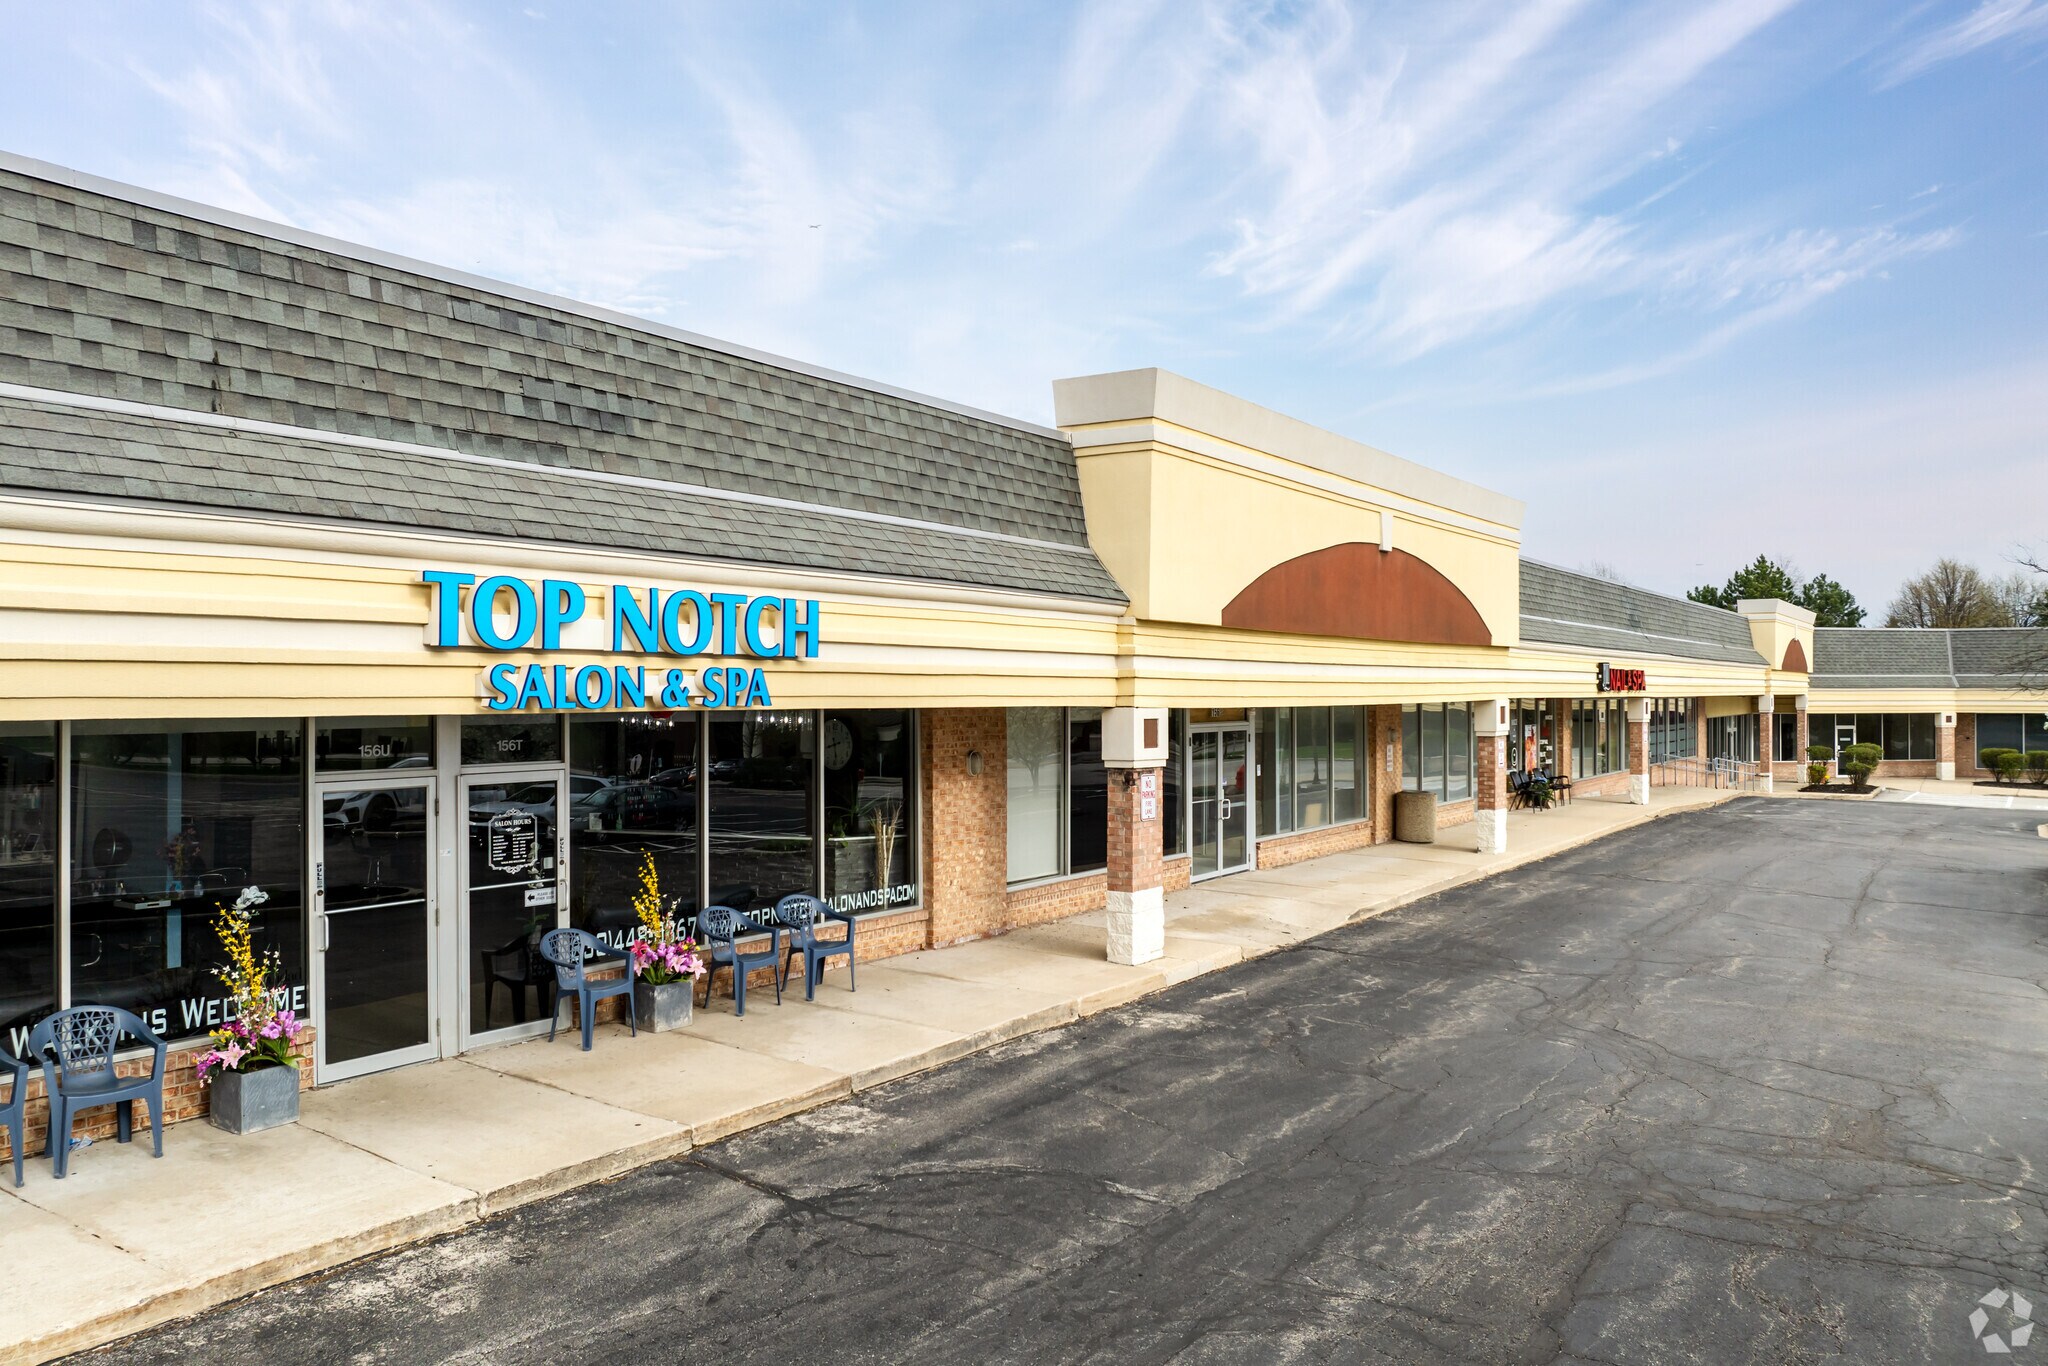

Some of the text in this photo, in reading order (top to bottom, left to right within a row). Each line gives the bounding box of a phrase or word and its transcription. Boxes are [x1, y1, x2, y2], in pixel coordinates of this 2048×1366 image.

[421, 569, 820, 659] TOP NOTCH
[488, 663, 773, 711] SALON & SPA
[1609, 668, 1628, 691] NAIL
[1632, 670, 1646, 691] SPA
[358, 744, 390, 758] 156U
[496, 739, 523, 752] 156T
[495, 818, 532, 828] SALON HOURS
[180, 985, 305, 1030] WELME
